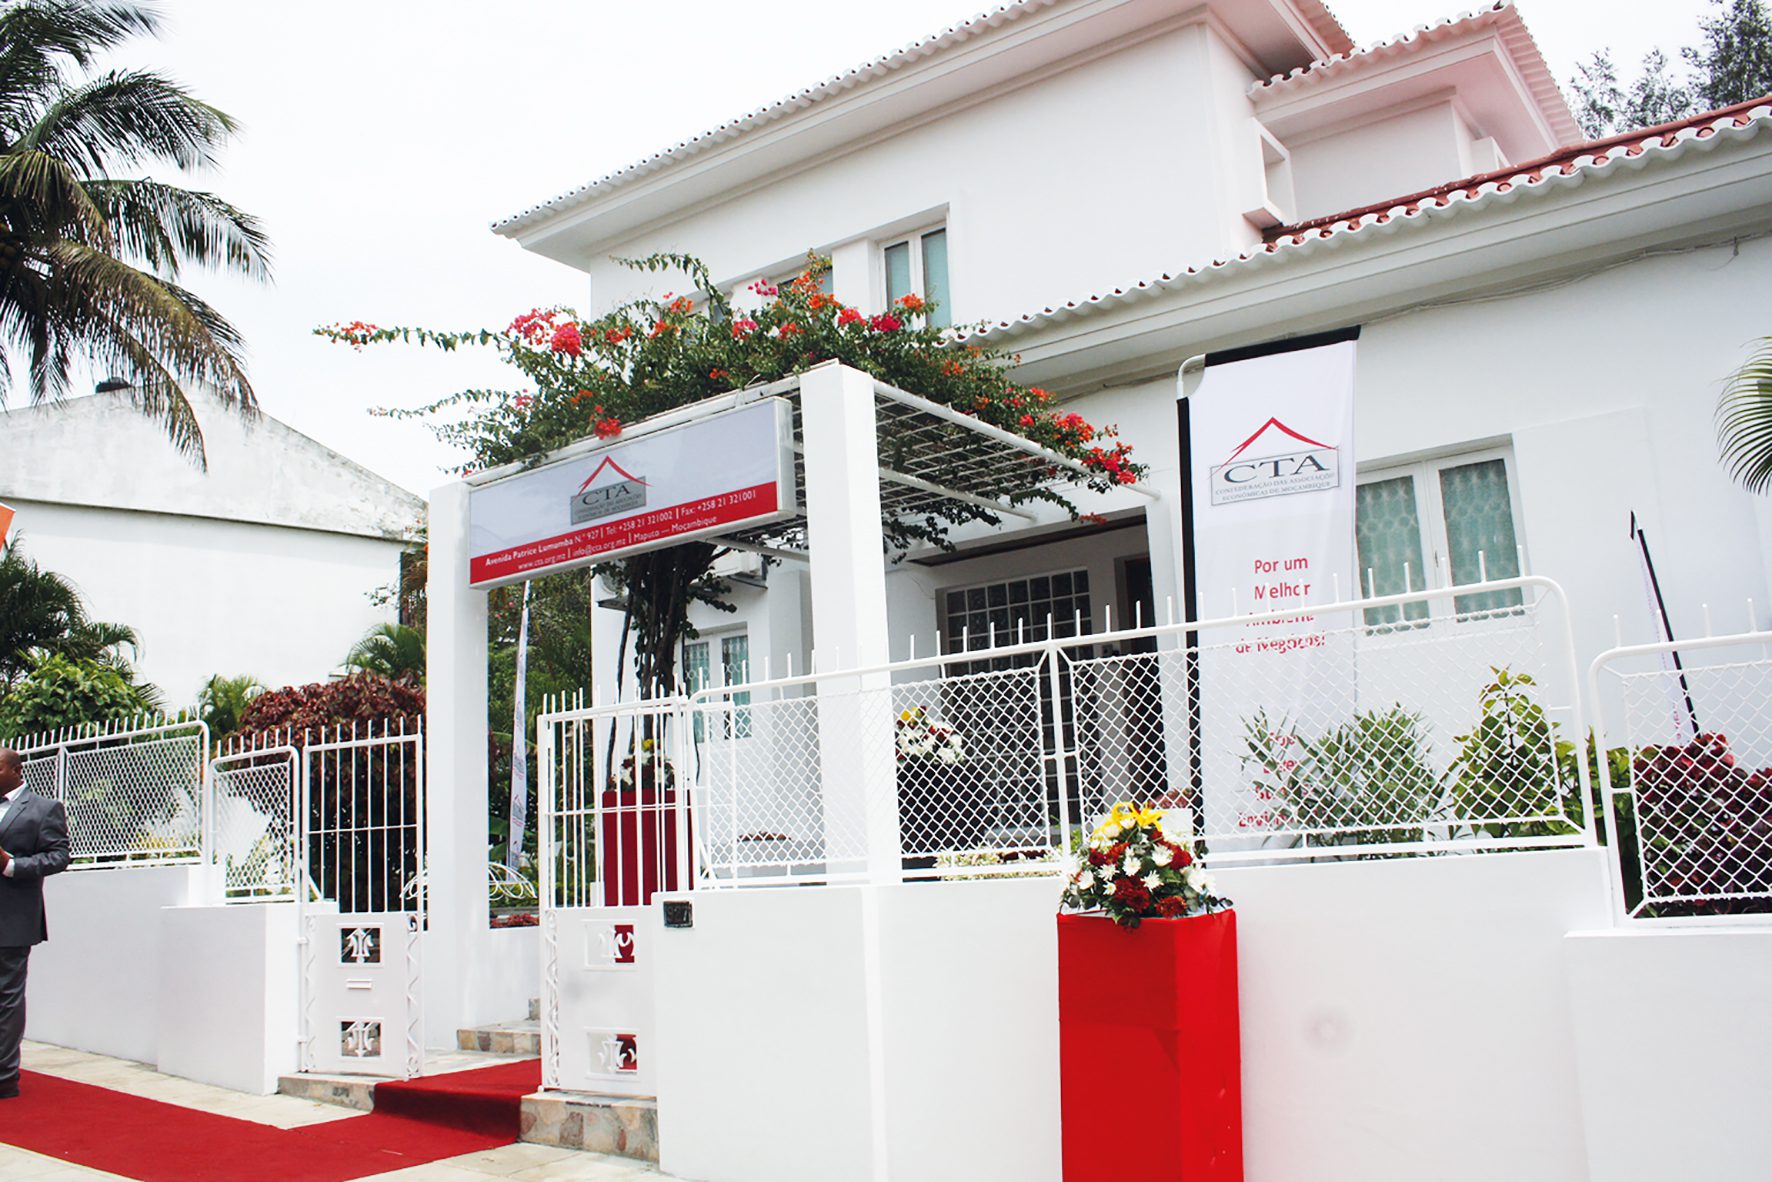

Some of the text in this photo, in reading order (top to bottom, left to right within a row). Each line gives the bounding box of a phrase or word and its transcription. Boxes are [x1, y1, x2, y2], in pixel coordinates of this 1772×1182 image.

[1223, 454, 1331, 484] CTA
[582, 484, 631, 506] CTA
[1215, 481, 1273, 496] CONFEDERAÇÃO
[485, 552, 513, 567] Avenida
[513, 547, 537, 560] Patrice
[538, 538, 574, 554] Lumumba
[587, 529, 600, 541] 927
[619, 520, 636, 532] +258
[637, 518, 645, 528] 21
[647, 510, 673, 525] 321002
[697, 499, 716, 512] +258
[717, 497, 727, 508] 21
[729, 489, 757, 505] 321001
[572, 537, 627, 557] info@cta.org.mz
[633, 529, 660, 542] Maputo
[671, 515, 718, 534] Moçambique
[1254, 557, 1309, 574] Por um
[1254, 582, 1311, 601] Melhor
